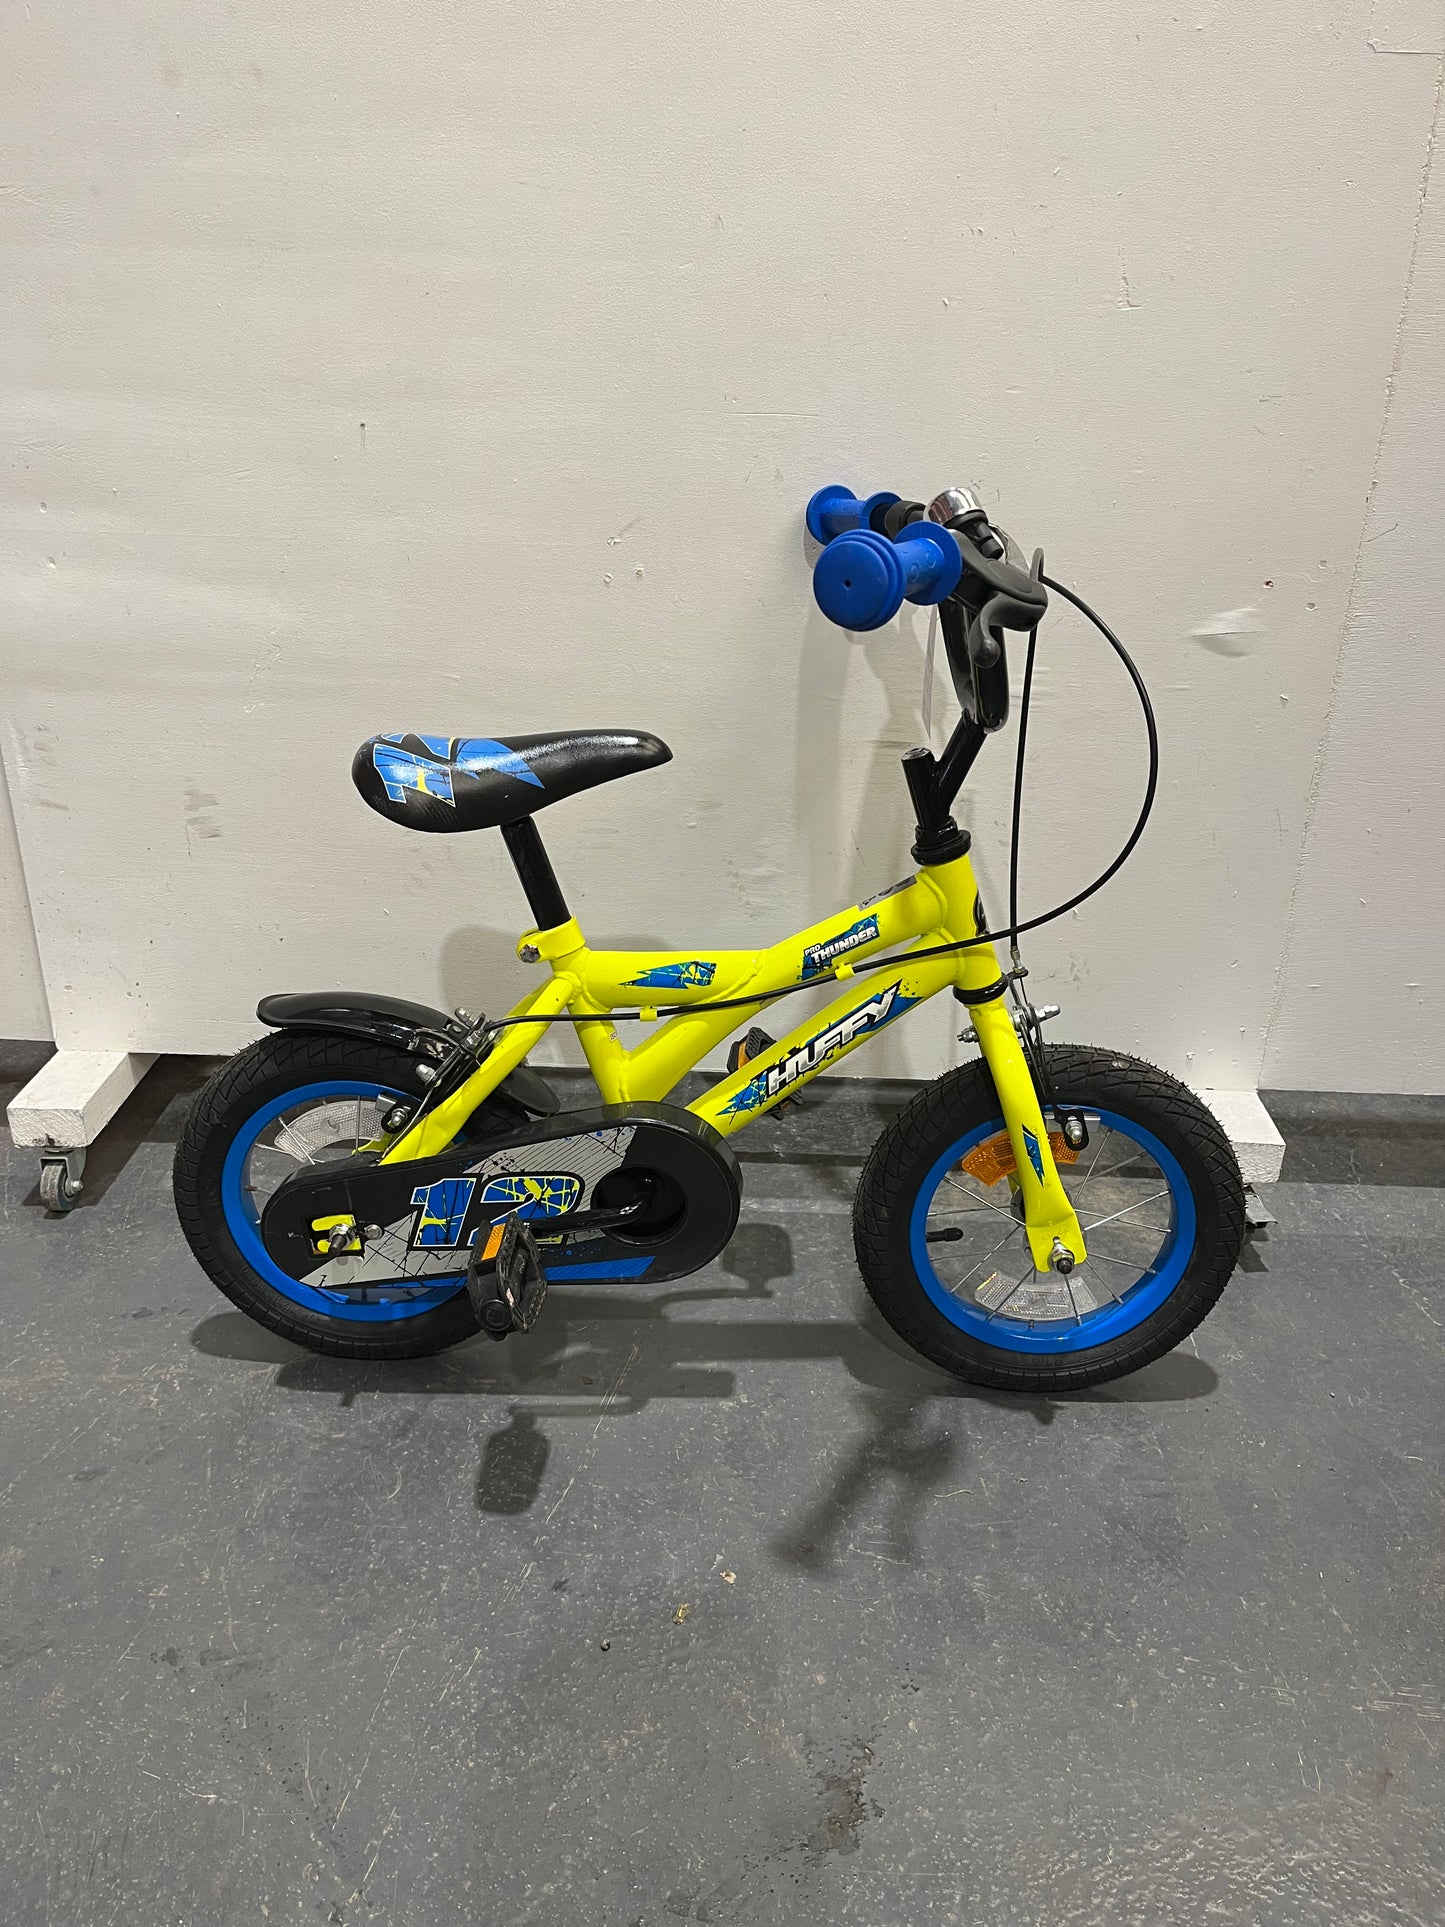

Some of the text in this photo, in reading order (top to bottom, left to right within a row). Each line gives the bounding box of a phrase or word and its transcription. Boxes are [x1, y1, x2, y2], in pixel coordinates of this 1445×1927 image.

[804, 944, 821, 956] PRO
[811, 926, 878, 963] THUNDER
[768, 984, 899, 1096] HUFFY
